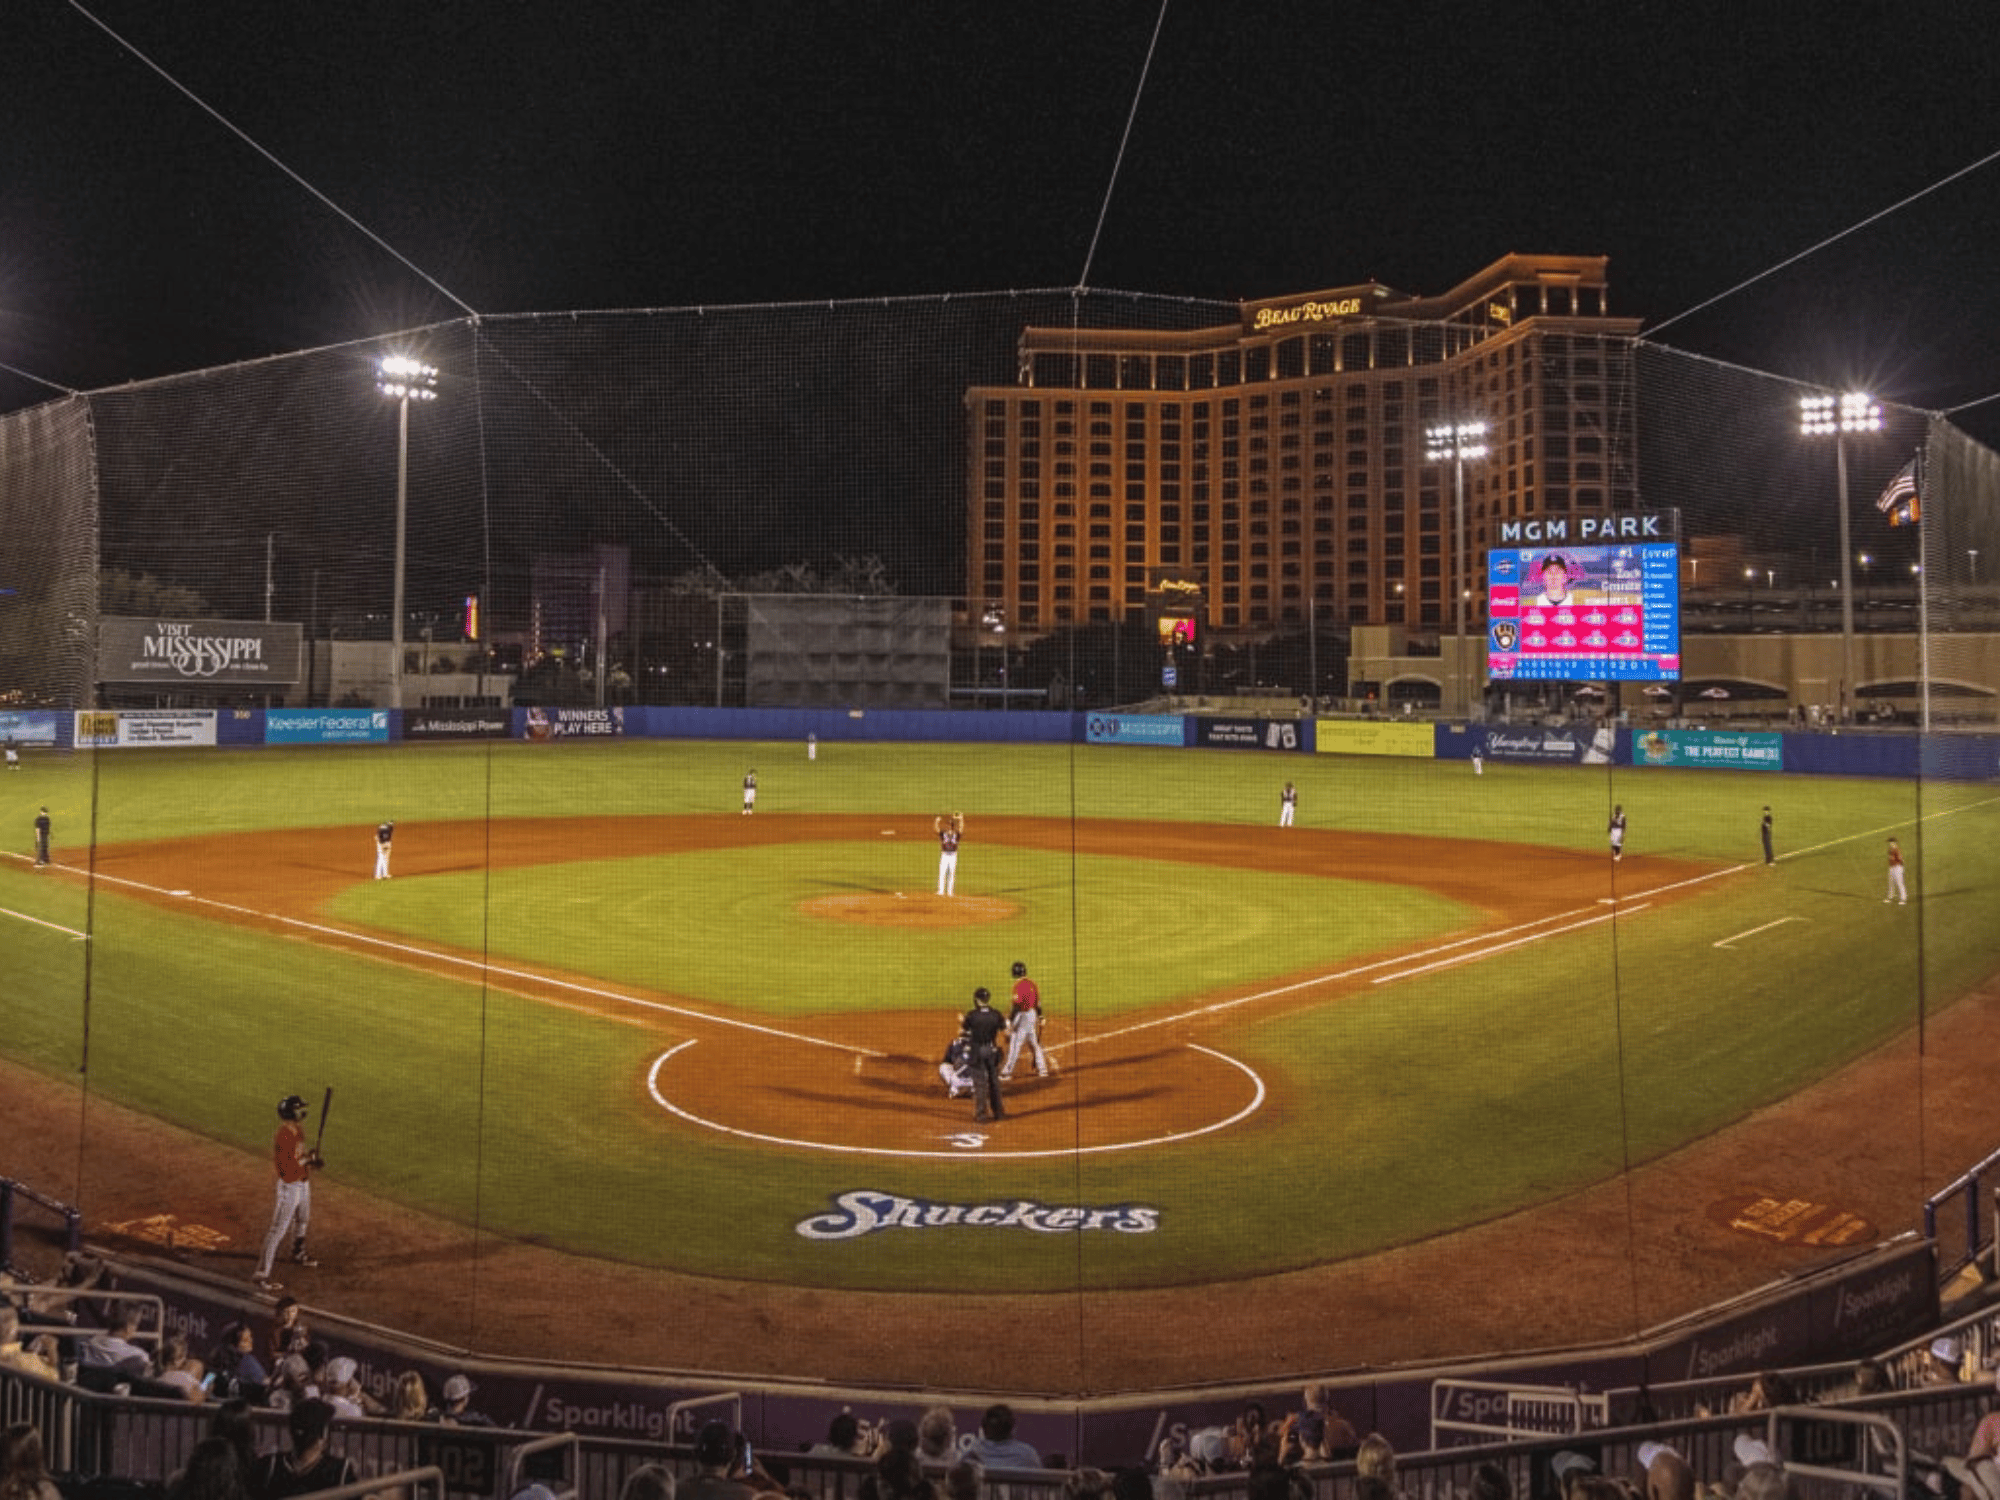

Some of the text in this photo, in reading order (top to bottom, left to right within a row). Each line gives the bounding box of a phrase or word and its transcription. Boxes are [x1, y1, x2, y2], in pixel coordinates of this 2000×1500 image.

[1254, 298, 1360, 329] BEAU RIVAGE
[1501, 515, 1659, 541] MGM PARK
[157, 623, 192, 636] VISIT
[143, 636, 262, 676] MISSISSIPPI
[428, 720, 504, 733] Mississippi Power
[554, 722, 612, 734] PLAY HERE
[558, 709, 608, 721] WINNERS
[795, 1190, 1159, 1239] Shuckers
[1698, 1326, 1778, 1377] Sparklight
